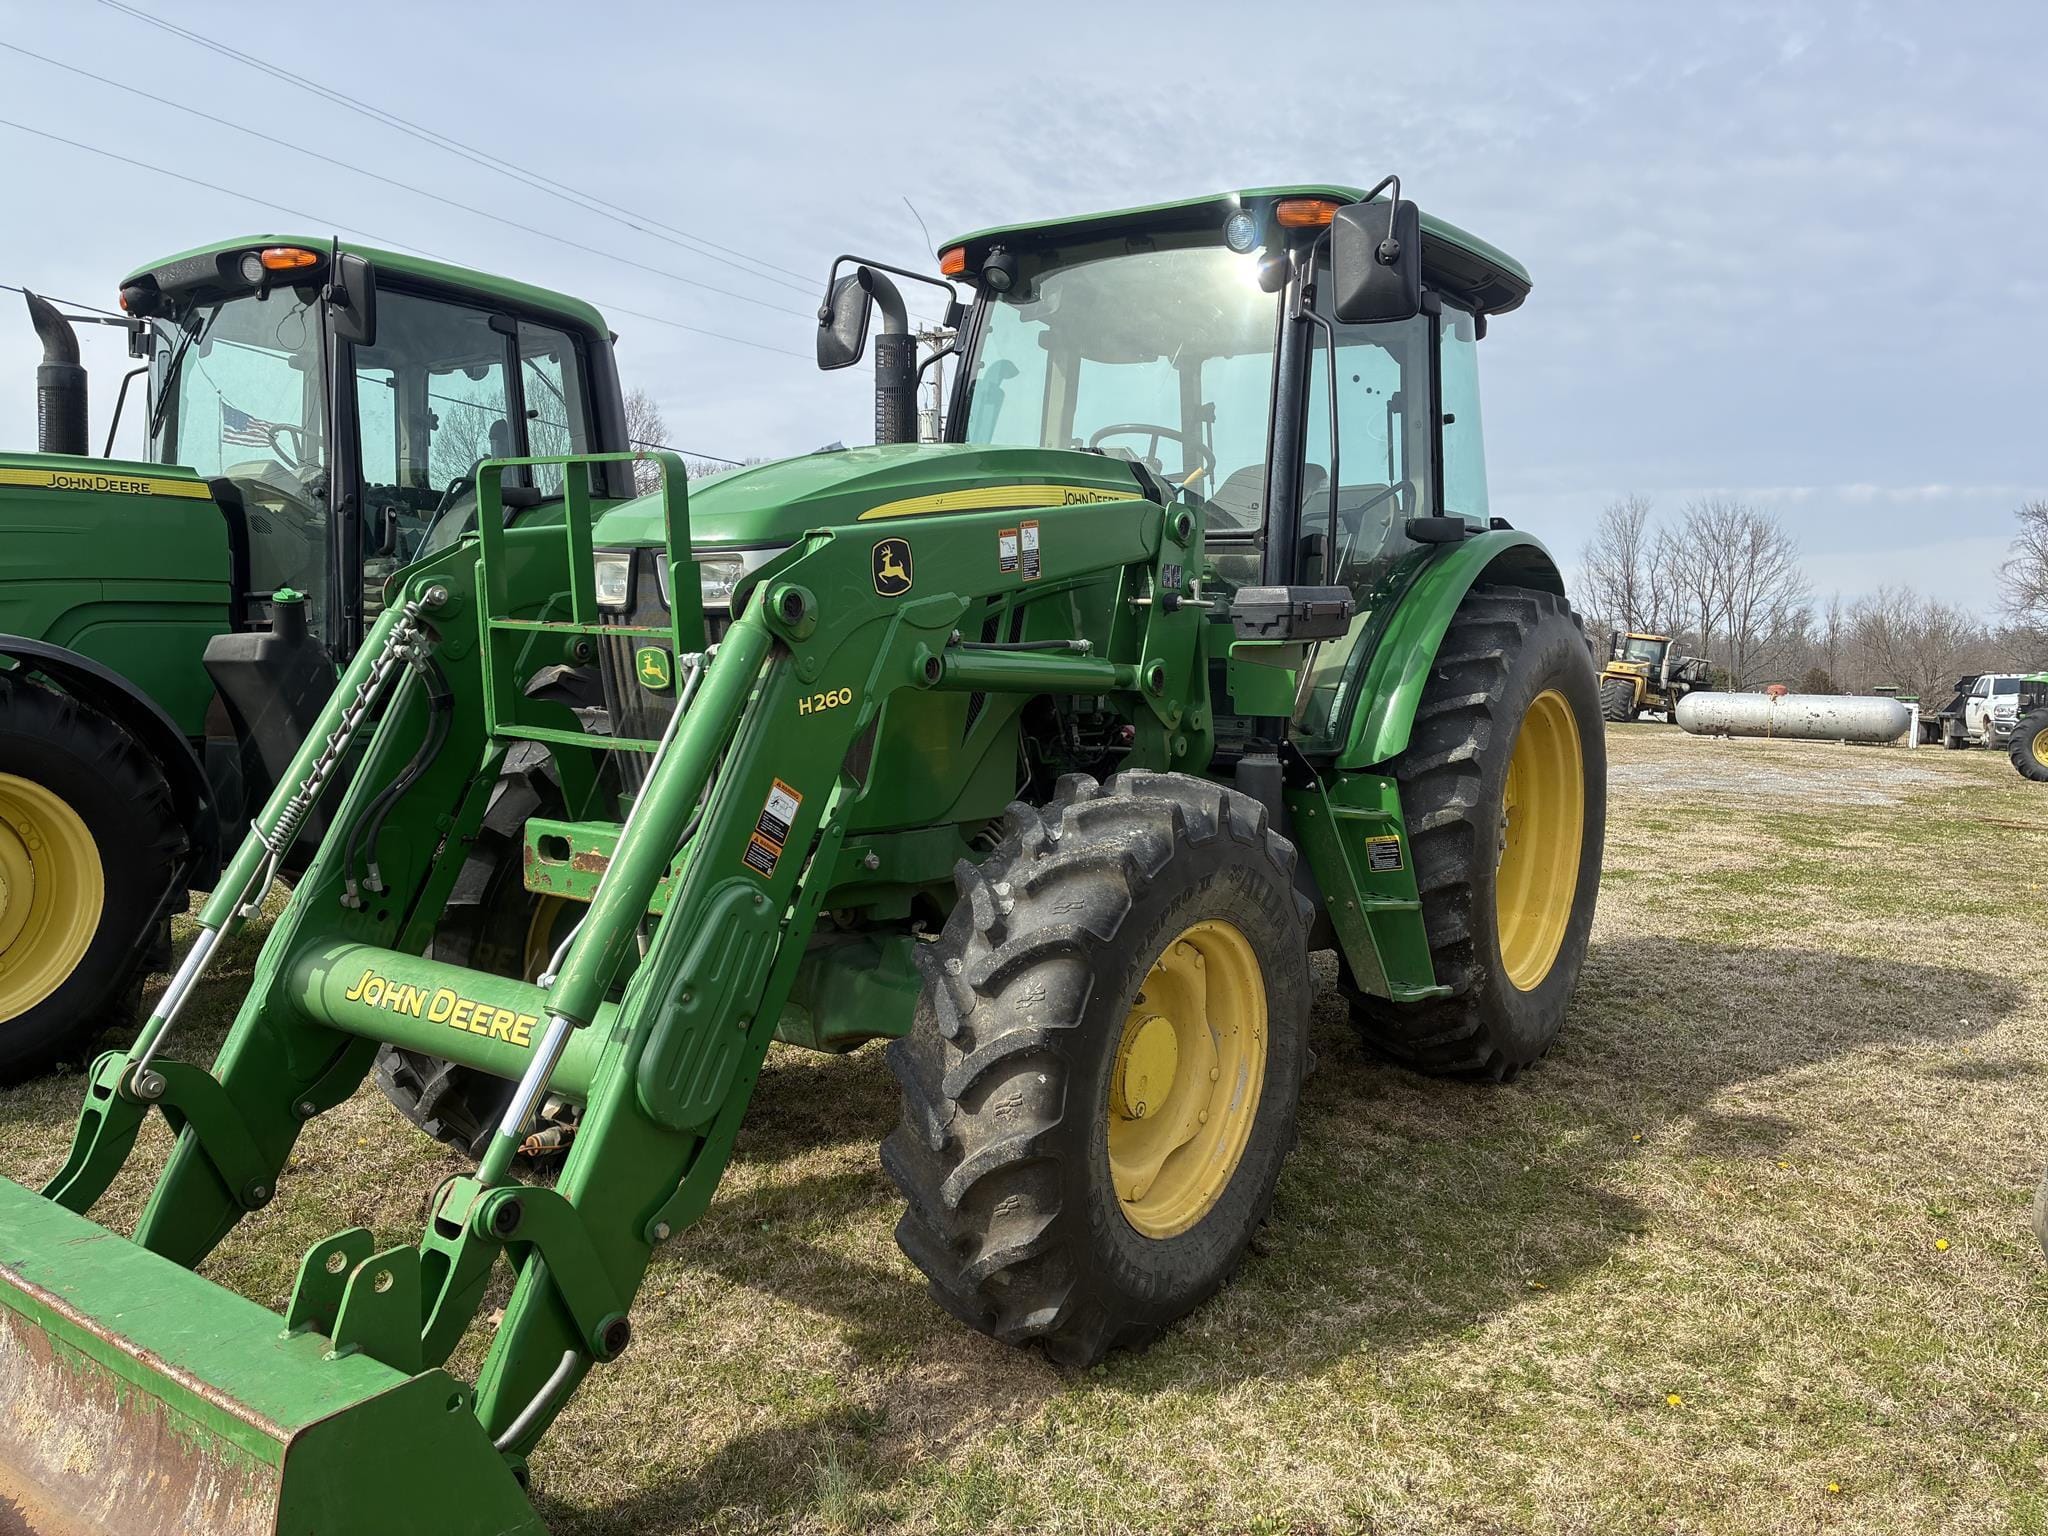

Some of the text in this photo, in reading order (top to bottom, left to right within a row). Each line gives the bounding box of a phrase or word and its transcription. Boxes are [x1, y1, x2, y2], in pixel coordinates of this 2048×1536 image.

[46, 473, 152, 494] JOHN DEERE
[1062, 489, 1088, 506] JOHN
[798, 687, 853, 716] H260
[345, 969, 538, 1047] JOHN DEERE
